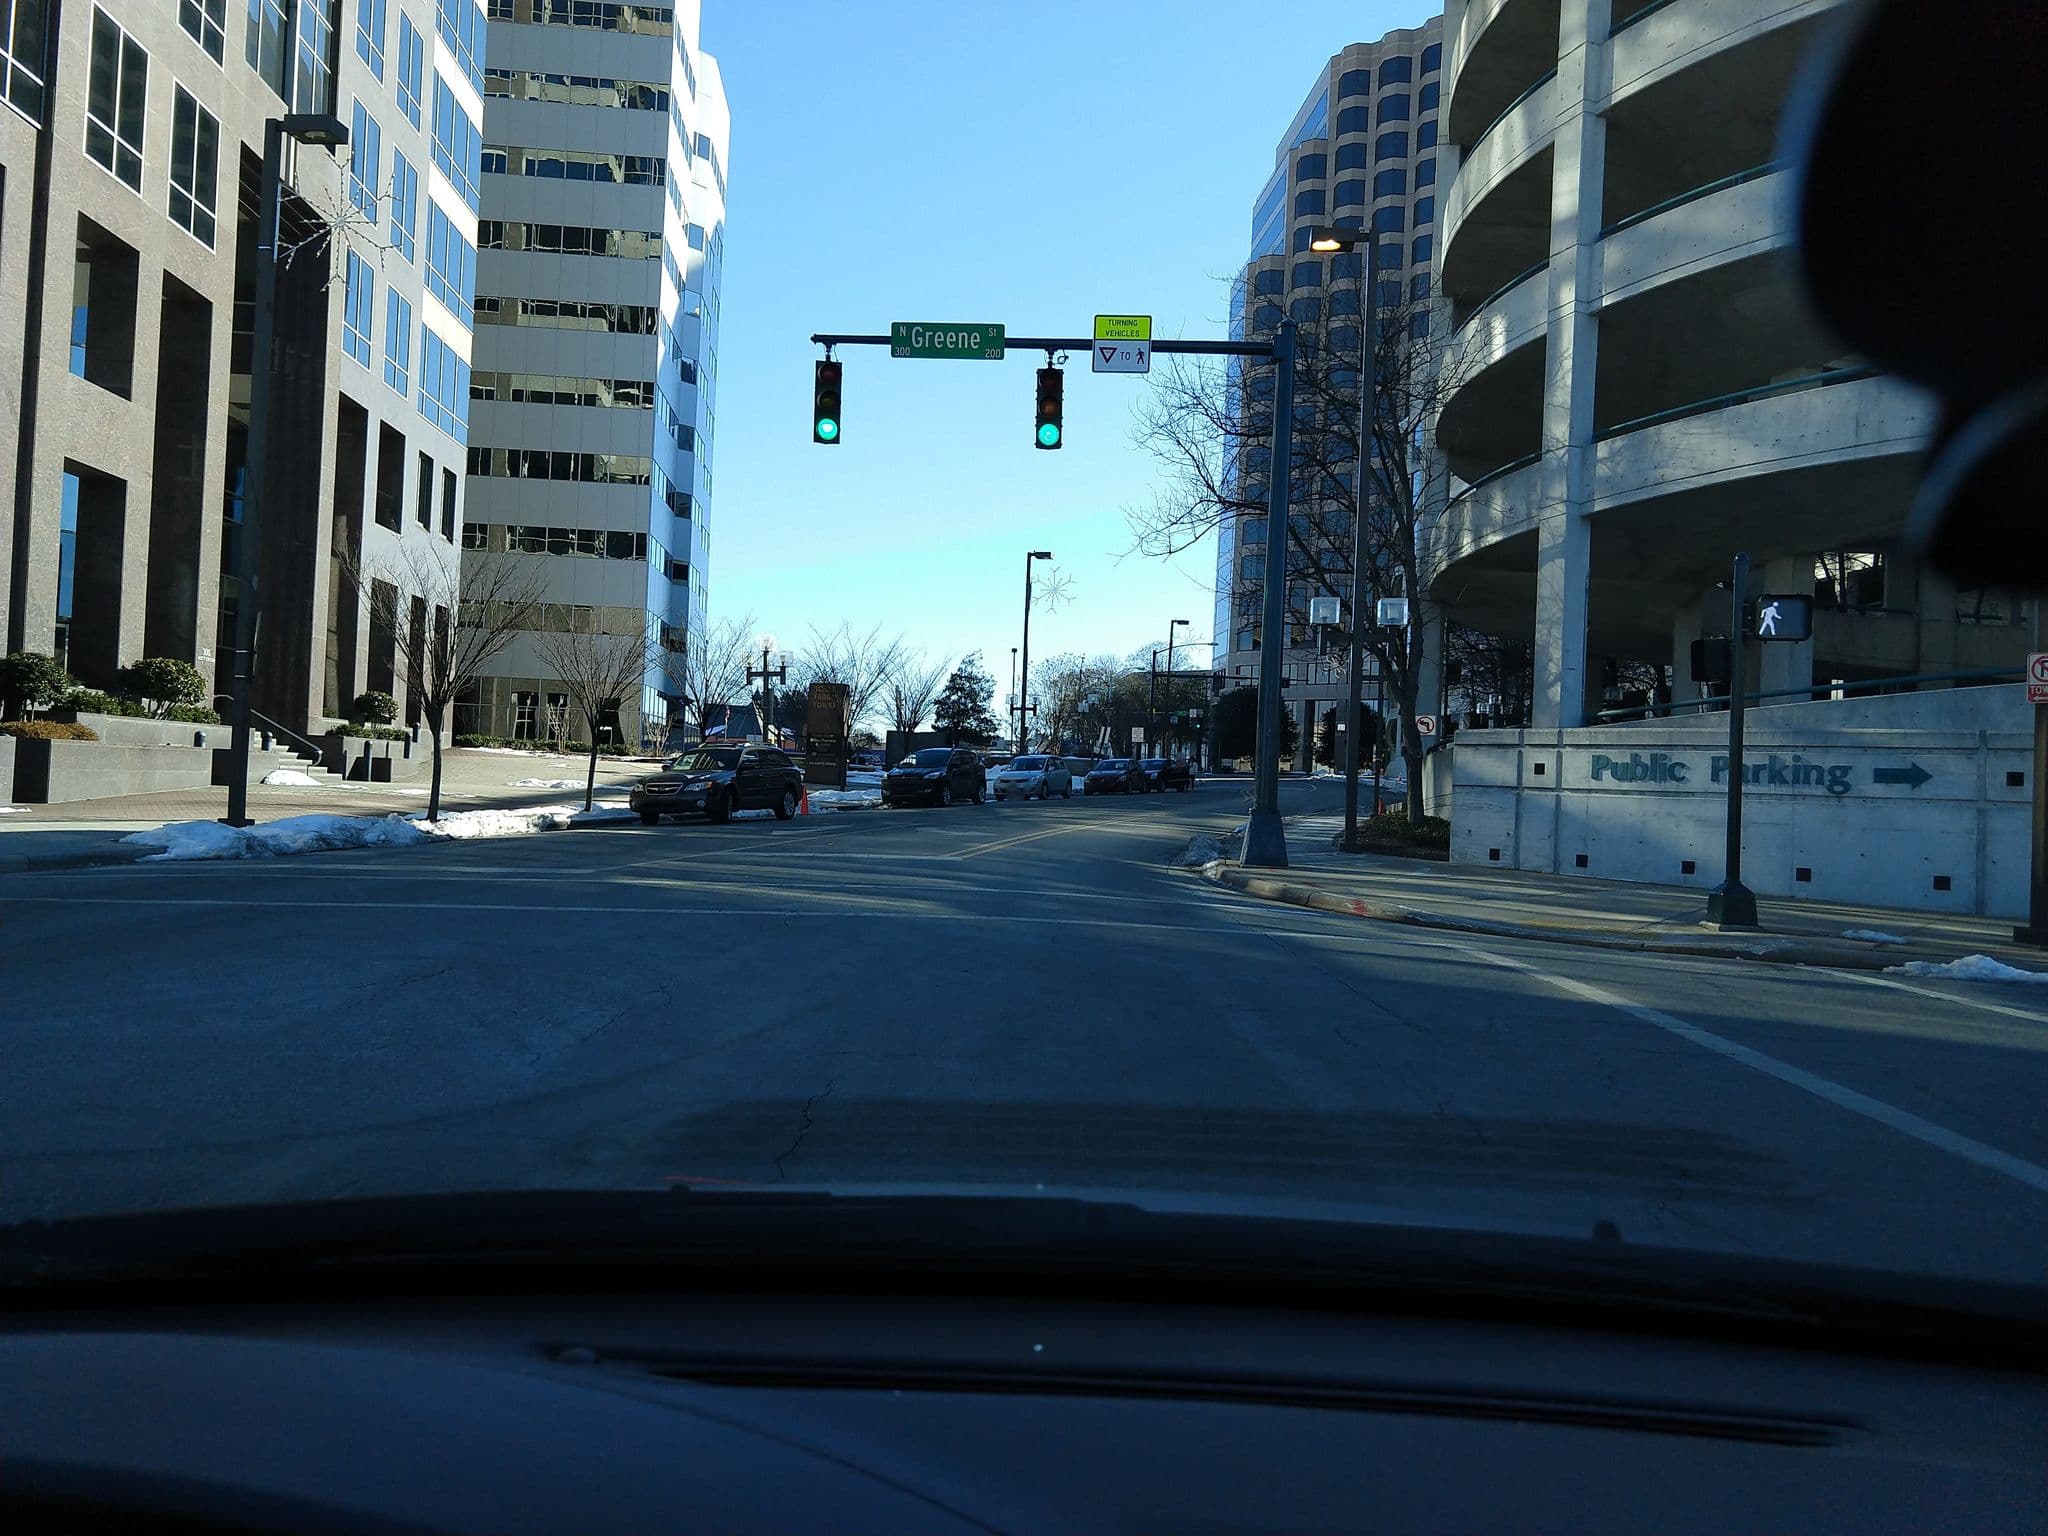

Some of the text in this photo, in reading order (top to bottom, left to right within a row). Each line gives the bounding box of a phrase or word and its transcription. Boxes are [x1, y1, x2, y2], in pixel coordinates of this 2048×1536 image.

[1108, 319, 1138, 327] TURNING
[899, 325, 997, 349] N Greene St
[1105, 329, 1140, 337] VEHICLES
[894, 346, 911, 356] 300
[985, 348, 1001, 358] 200
[1119, 351, 1131, 360] TO
[1590, 752, 1687, 782] Public
